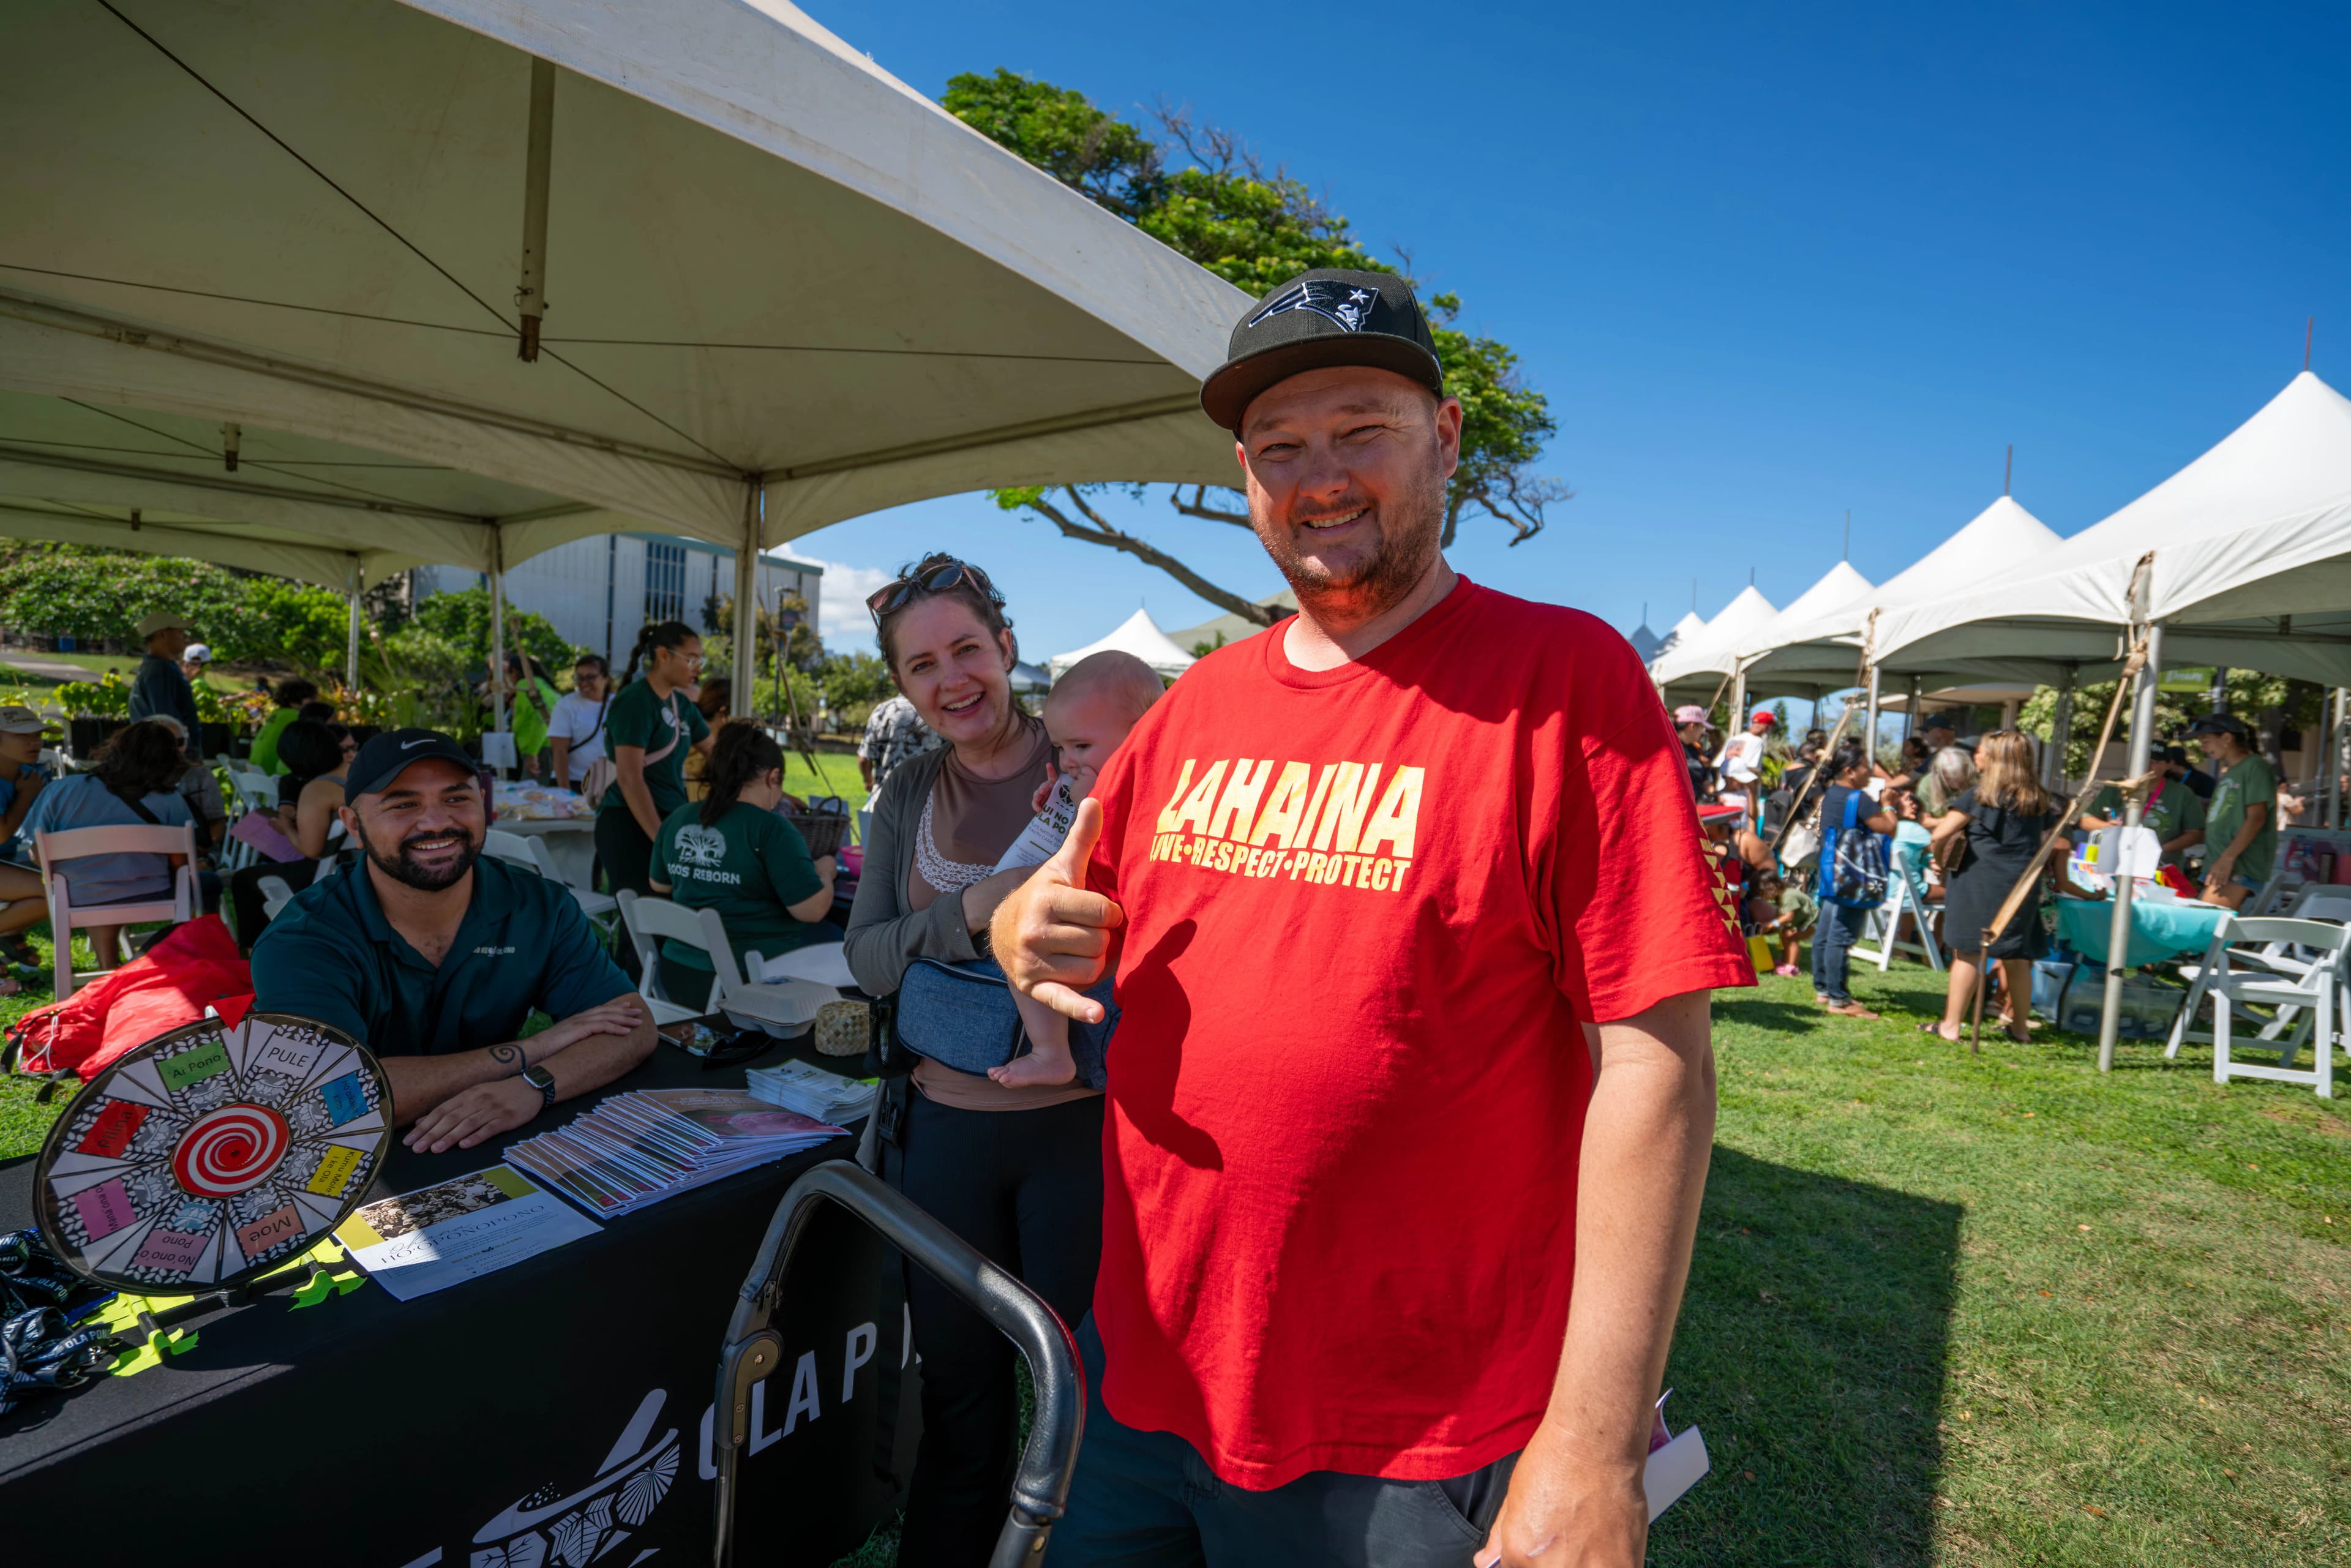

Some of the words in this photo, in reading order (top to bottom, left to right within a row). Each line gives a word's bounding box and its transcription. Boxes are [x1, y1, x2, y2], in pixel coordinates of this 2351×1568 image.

[1043, 804, 1054, 815] UI
[1054, 811, 1069, 825] NO
[1156, 758, 1425, 858] LAHAINA
[1052, 822, 1066, 834] PO
[693, 868, 741, 884] REBORN
[189, 1054, 221, 1072] Pono
[268, 1047, 309, 1067] PULE
[327, 1160, 338, 1169] ke
[338, 1151, 355, 1172] Kumu
[319, 1171, 331, 1182] Ola
[327, 1174, 343, 1193] Mole
[249, 1216, 291, 1242] Moe
[162, 1236, 194, 1248] Pono
[65, 1334, 89, 1349] OLA
